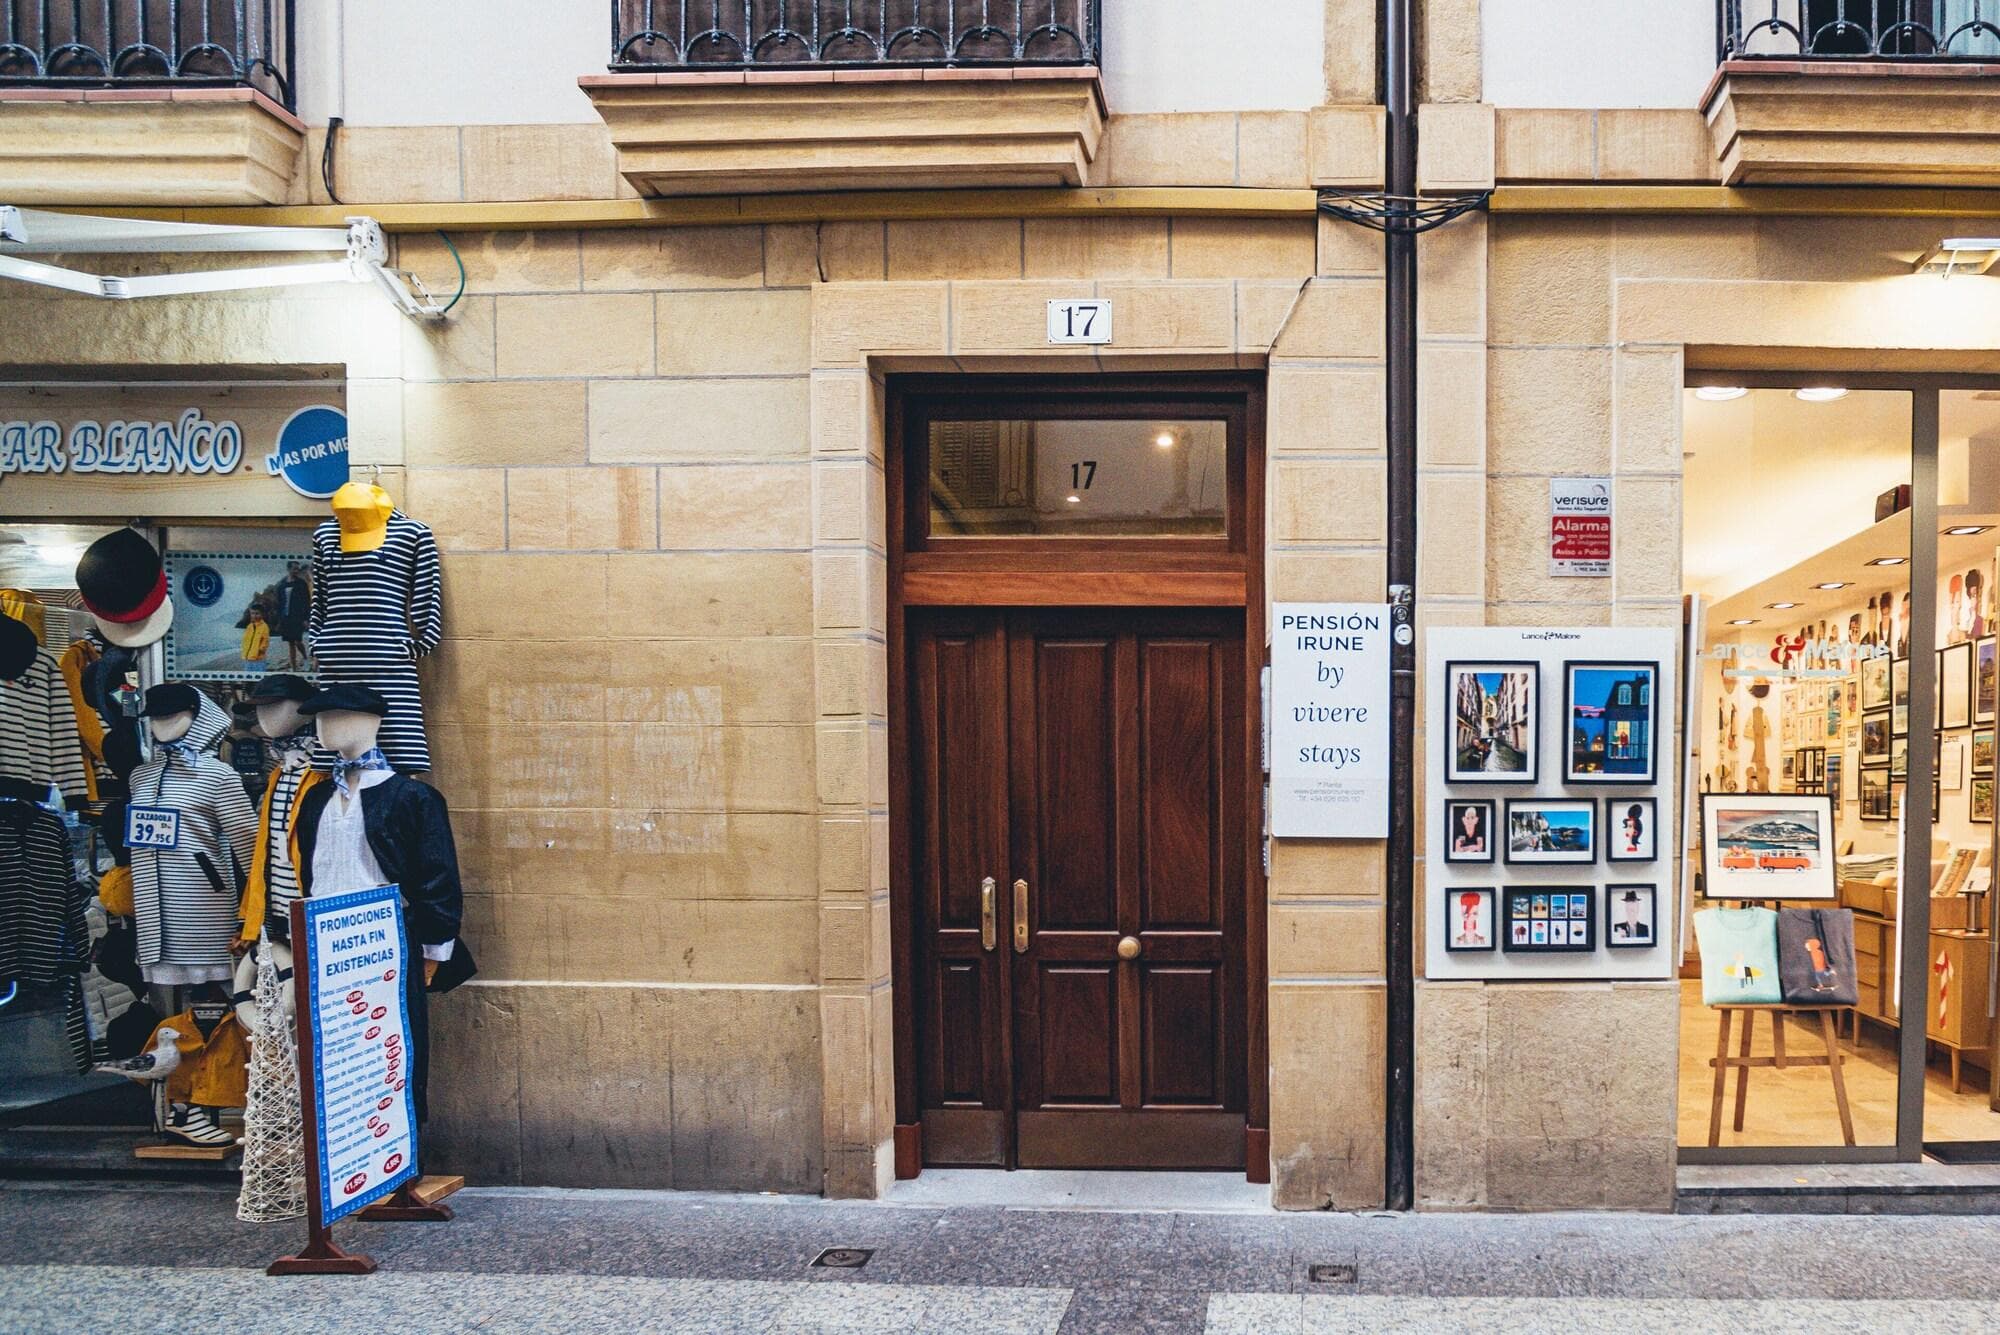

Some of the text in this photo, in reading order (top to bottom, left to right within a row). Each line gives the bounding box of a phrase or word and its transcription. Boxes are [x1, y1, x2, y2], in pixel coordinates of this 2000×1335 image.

[1061, 305, 1099, 337] 17
[73, 411, 238, 466] BLANCO
[268, 450, 301, 472] MAS
[301, 443, 328, 462] POR
[1071, 460, 1097, 489] 17
[1554, 496, 1609, 506] verisure
[1554, 519, 1609, 531] Alarma
[1282, 612, 1379, 630] PENSIÓN
[1297, 636, 1364, 651] IRUNE
[1805, 638, 1890, 660] Malone
[1317, 660, 1345, 689] by
[1293, 701, 1368, 723] vivere
[1299, 744, 1361, 770] stays
[135, 812, 172, 822] CAZADORA
[320, 906, 393, 934] PROMOCIONES
[332, 929, 386, 953] HASTA FIN
[326, 948, 394, 977] EXISTENCIAS
